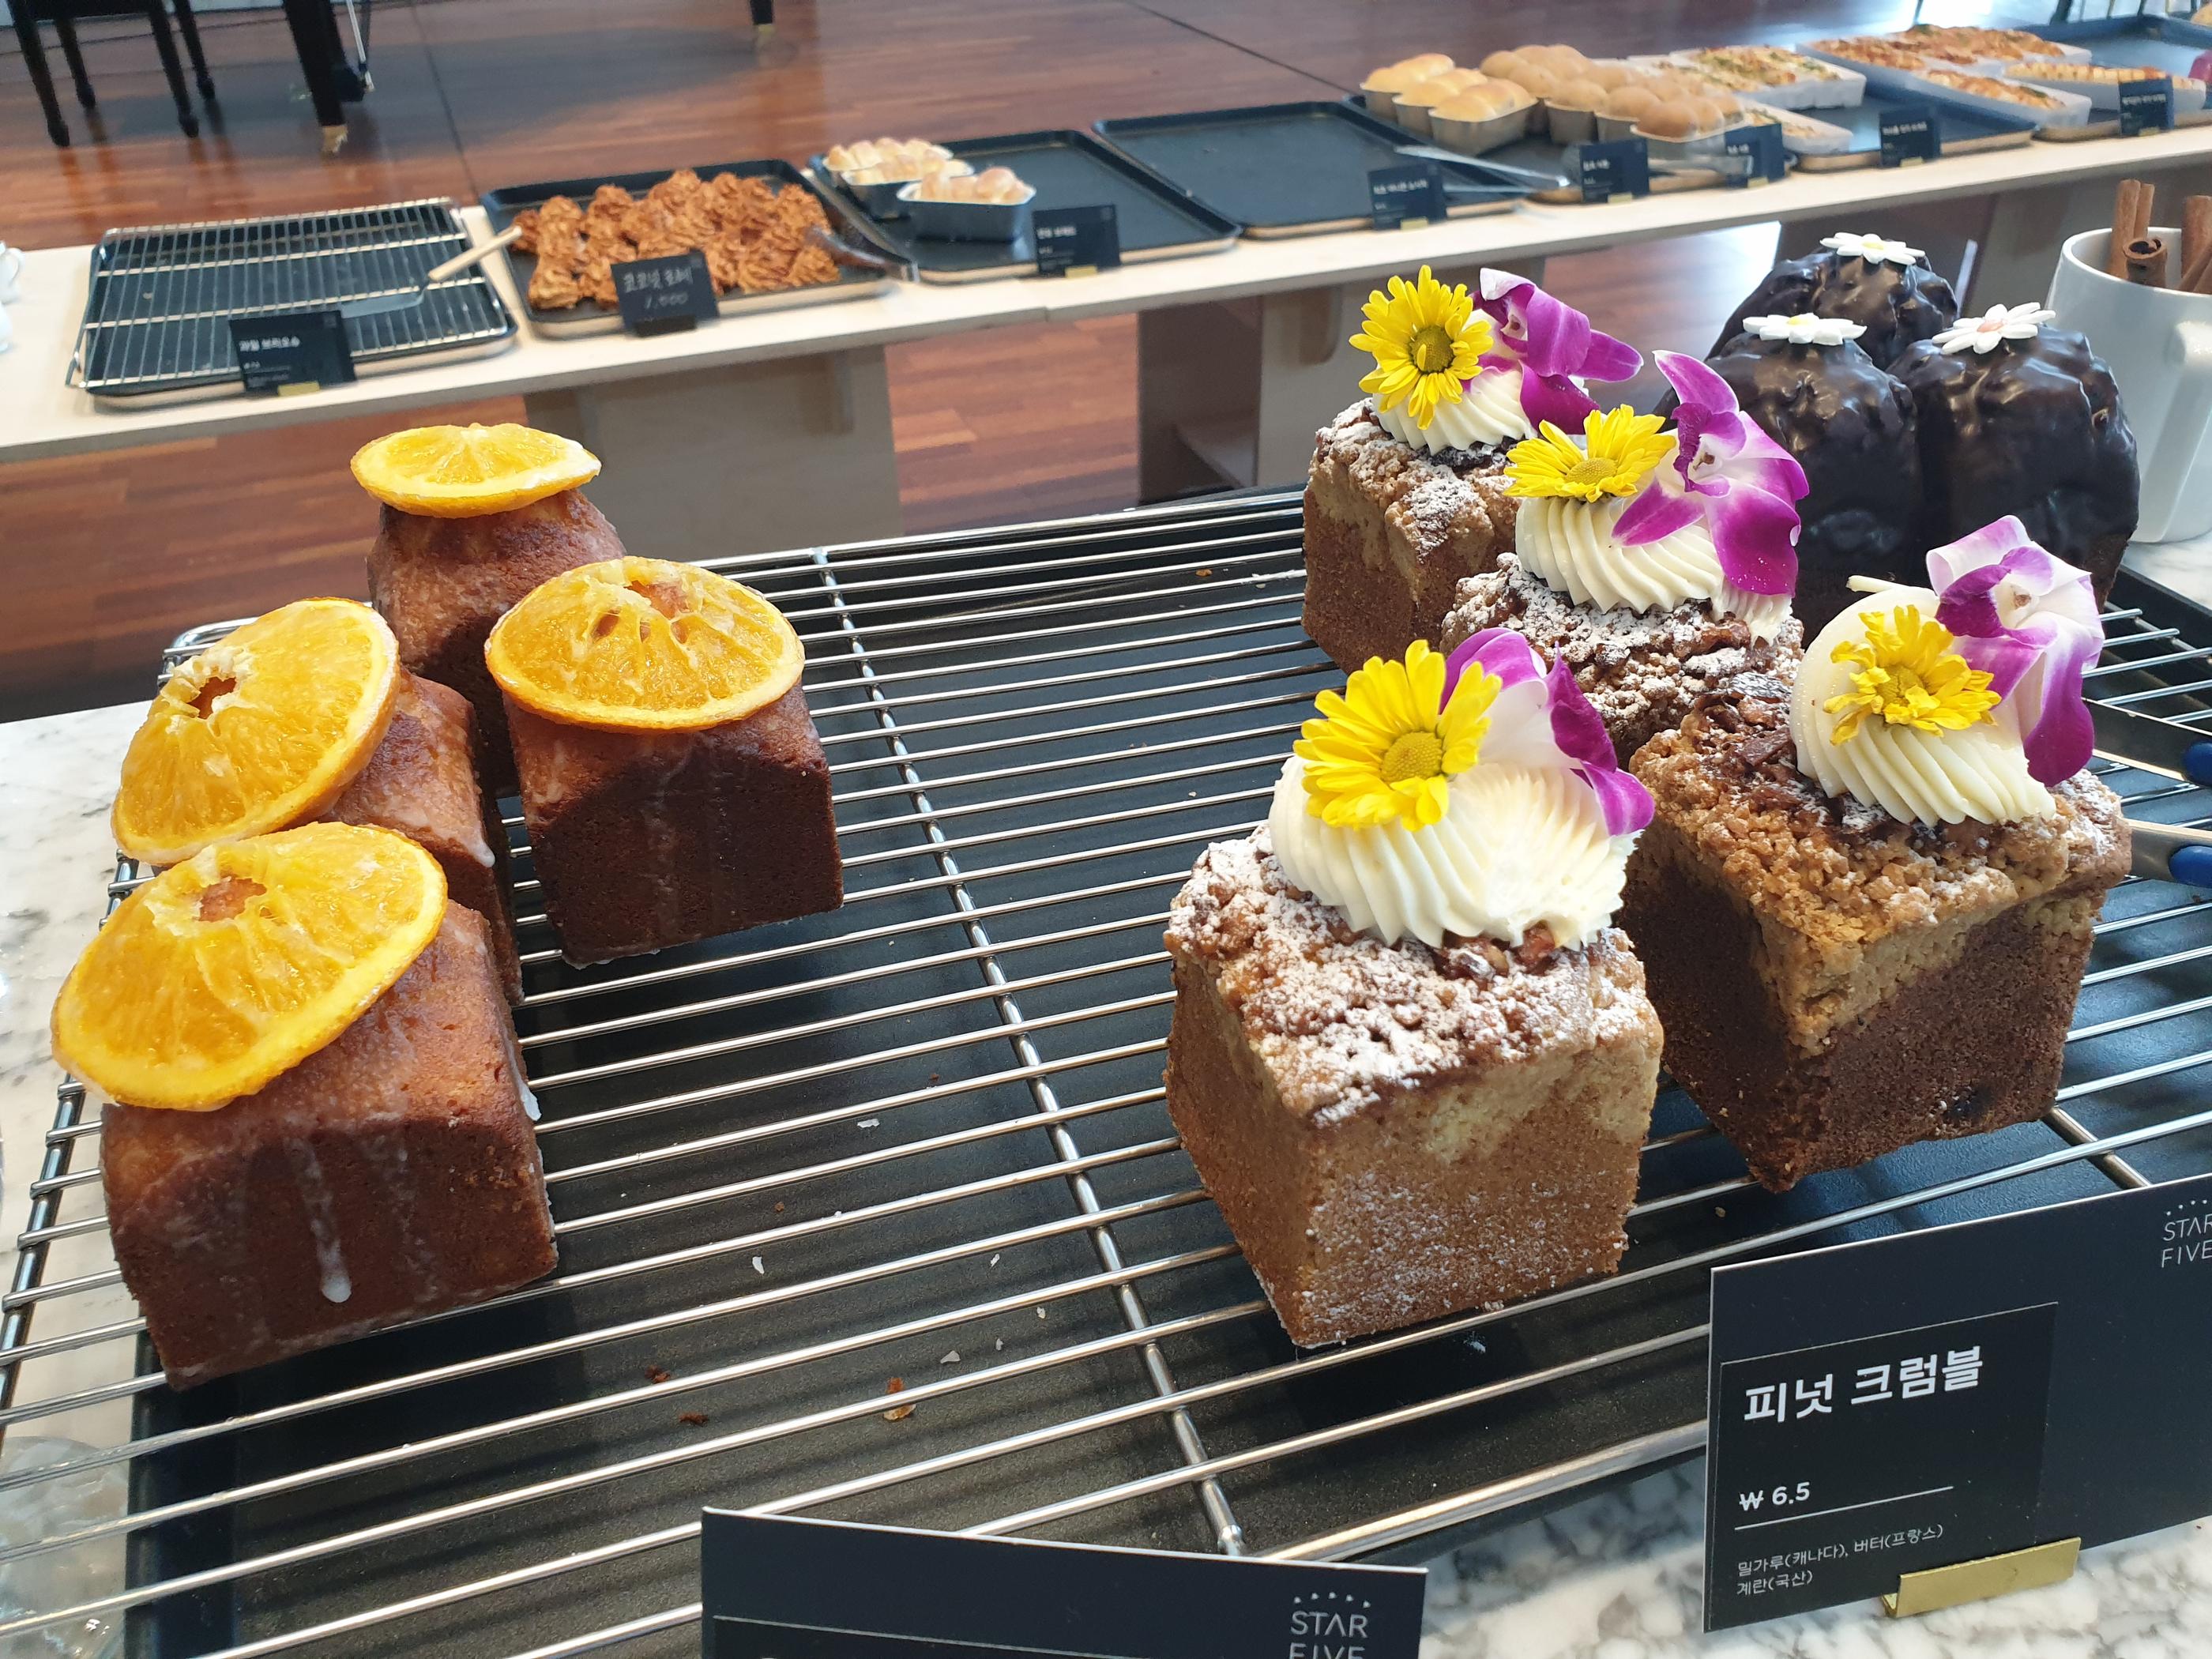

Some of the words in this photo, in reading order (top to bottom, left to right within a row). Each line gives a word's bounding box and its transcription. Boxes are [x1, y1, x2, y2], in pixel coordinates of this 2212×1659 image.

[2162, 1213, 2212, 1241] STAR
[2161, 1239, 2212, 1269] FIVE
[1744, 1372, 1834, 1423] 피넛
[1850, 1345, 1984, 1405] 크럼블
[1771, 1481, 1811, 1507] 6.5
[1853, 1523, 1944, 1553] 버터(프랑스)
[1736, 1570, 1814, 1597] 계란(국산)
[1290, 1610, 1369, 1638] STAR
